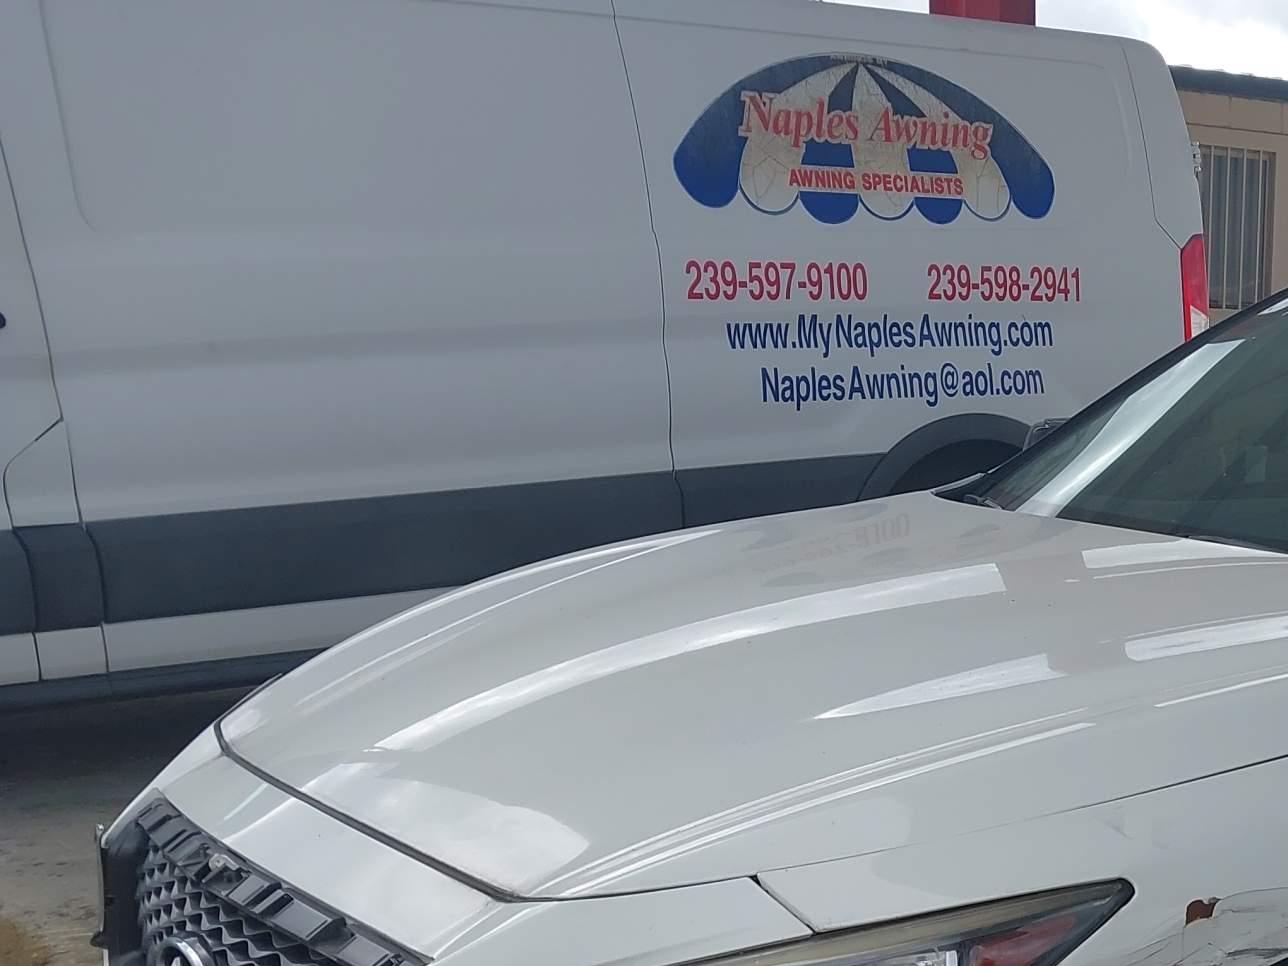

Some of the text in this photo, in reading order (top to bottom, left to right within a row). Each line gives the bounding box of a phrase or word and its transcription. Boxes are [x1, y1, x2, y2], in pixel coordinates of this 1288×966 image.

[742, 95, 993, 160] Naples Awning
[788, 169, 964, 196] AWNING SPECIALISTS
[684, 260, 868, 300] 239-597-9100
[927, 264, 1081, 302] 239-598-2941
[760, 363, 1045, 410] NaplesAwning@aol.com
